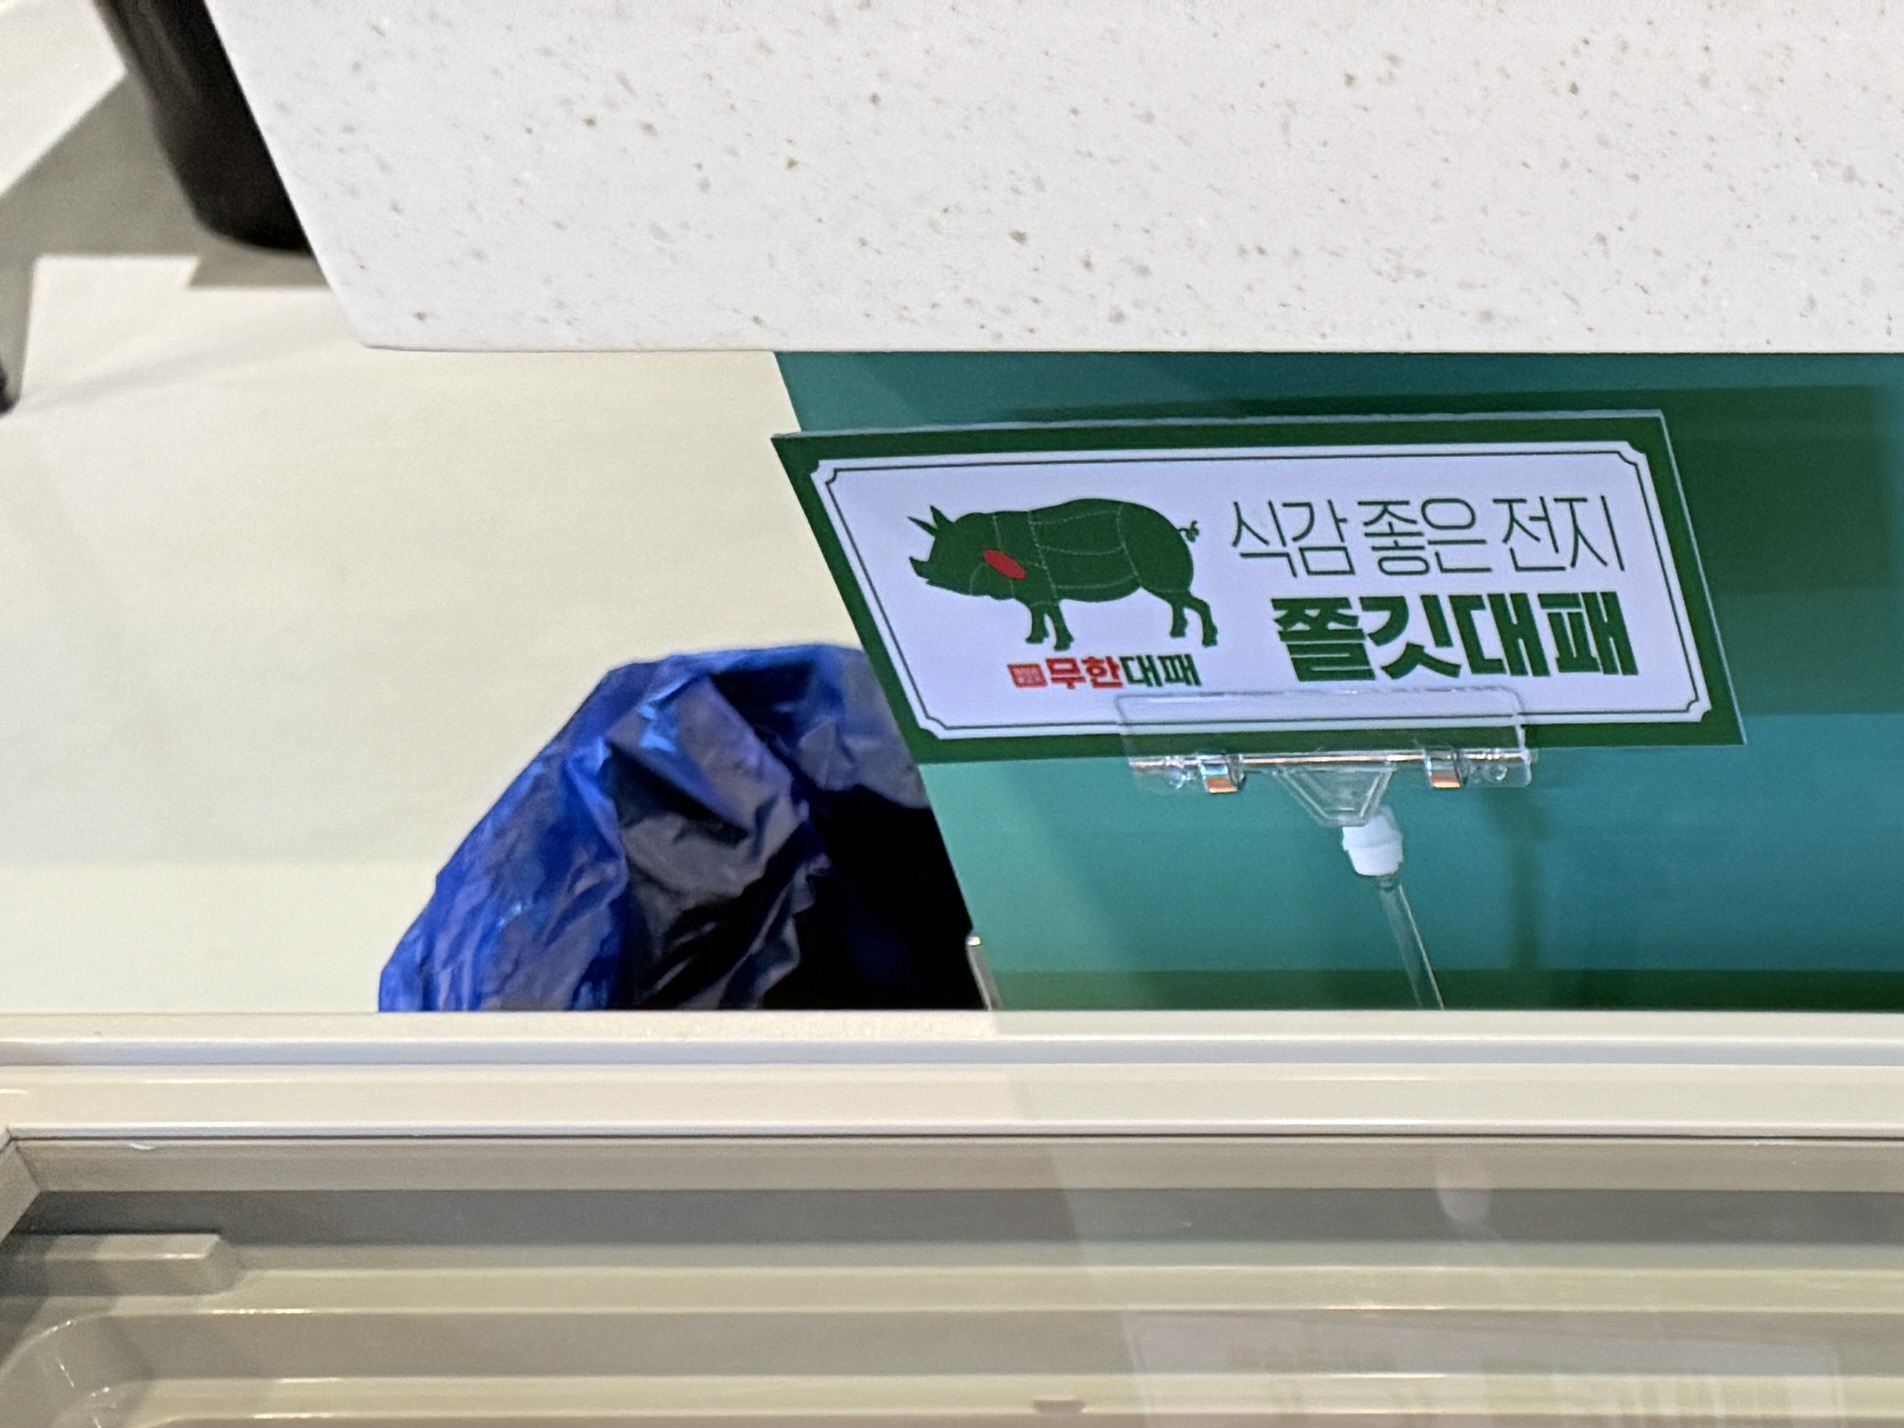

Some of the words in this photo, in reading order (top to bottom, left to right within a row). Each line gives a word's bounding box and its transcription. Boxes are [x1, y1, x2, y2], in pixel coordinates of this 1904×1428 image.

[1229, 497, 1355, 578] 식감
[1357, 497, 1493, 576] 좋은
[1494, 494, 1626, 573] 전지
[1045, 653, 1202, 690] 무한대패
[1270, 591, 1639, 683] 쫄깃대패
